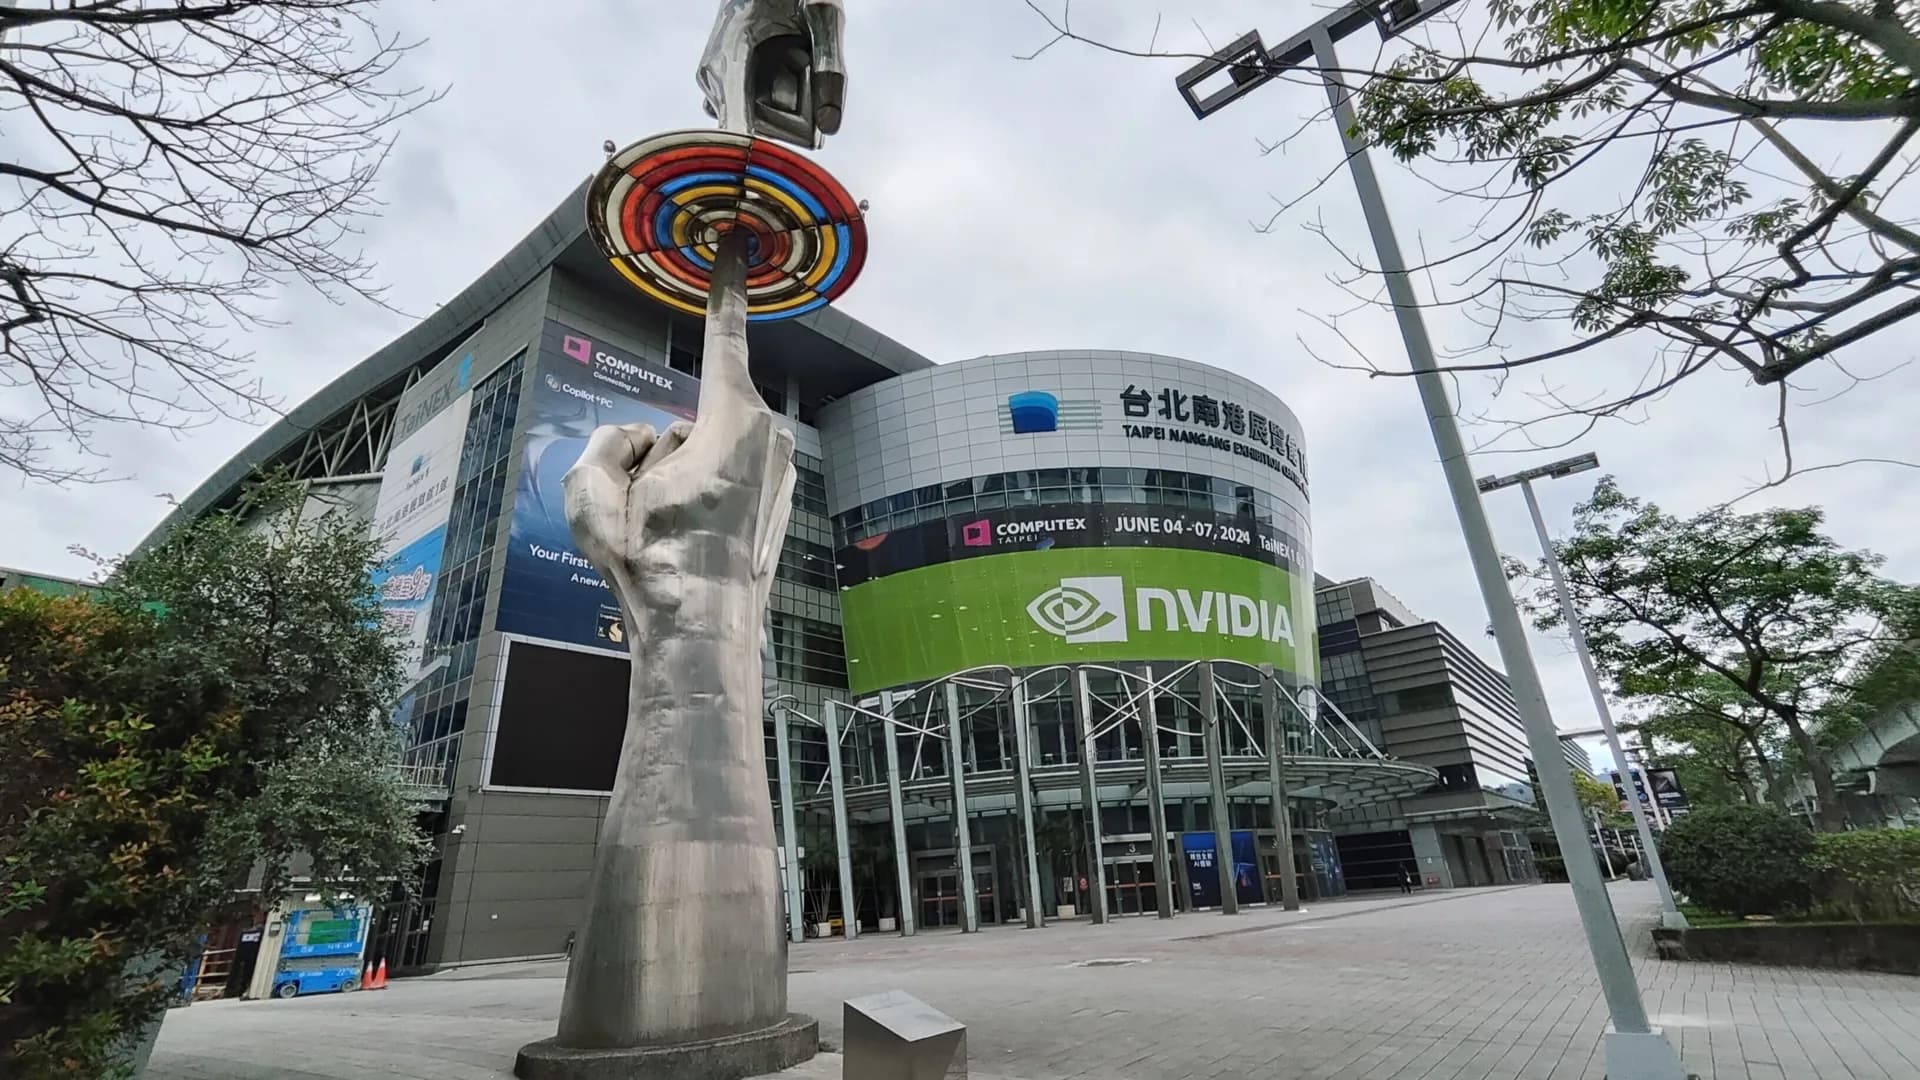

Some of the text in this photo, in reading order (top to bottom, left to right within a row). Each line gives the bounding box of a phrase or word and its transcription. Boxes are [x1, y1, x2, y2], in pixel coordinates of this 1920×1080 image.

[594, 361, 631, 381] TAIPEI
[595, 351, 673, 391] COMPUTEX
[593, 371, 632, 392] Connecting
[1122, 424, 1165, 440] TAIPEI
[1169, 428, 1231, 452] NANGANG
[996, 518, 1087, 536] COMPUTEX
[998, 534, 1038, 545] TAIPEI
[1114, 516, 1160, 533] JUNE
[1163, 518, 1183, 534] 04
[1220, 526, 1251, 545] 2024
[1258, 534, 1290, 561] TaiNEX
[529, 543, 560, 563] Your
[561, 552, 589, 569] First
[571, 573, 579, 583] A
[579, 576, 599, 587] new
[1129, 843, 1136, 853] 3
